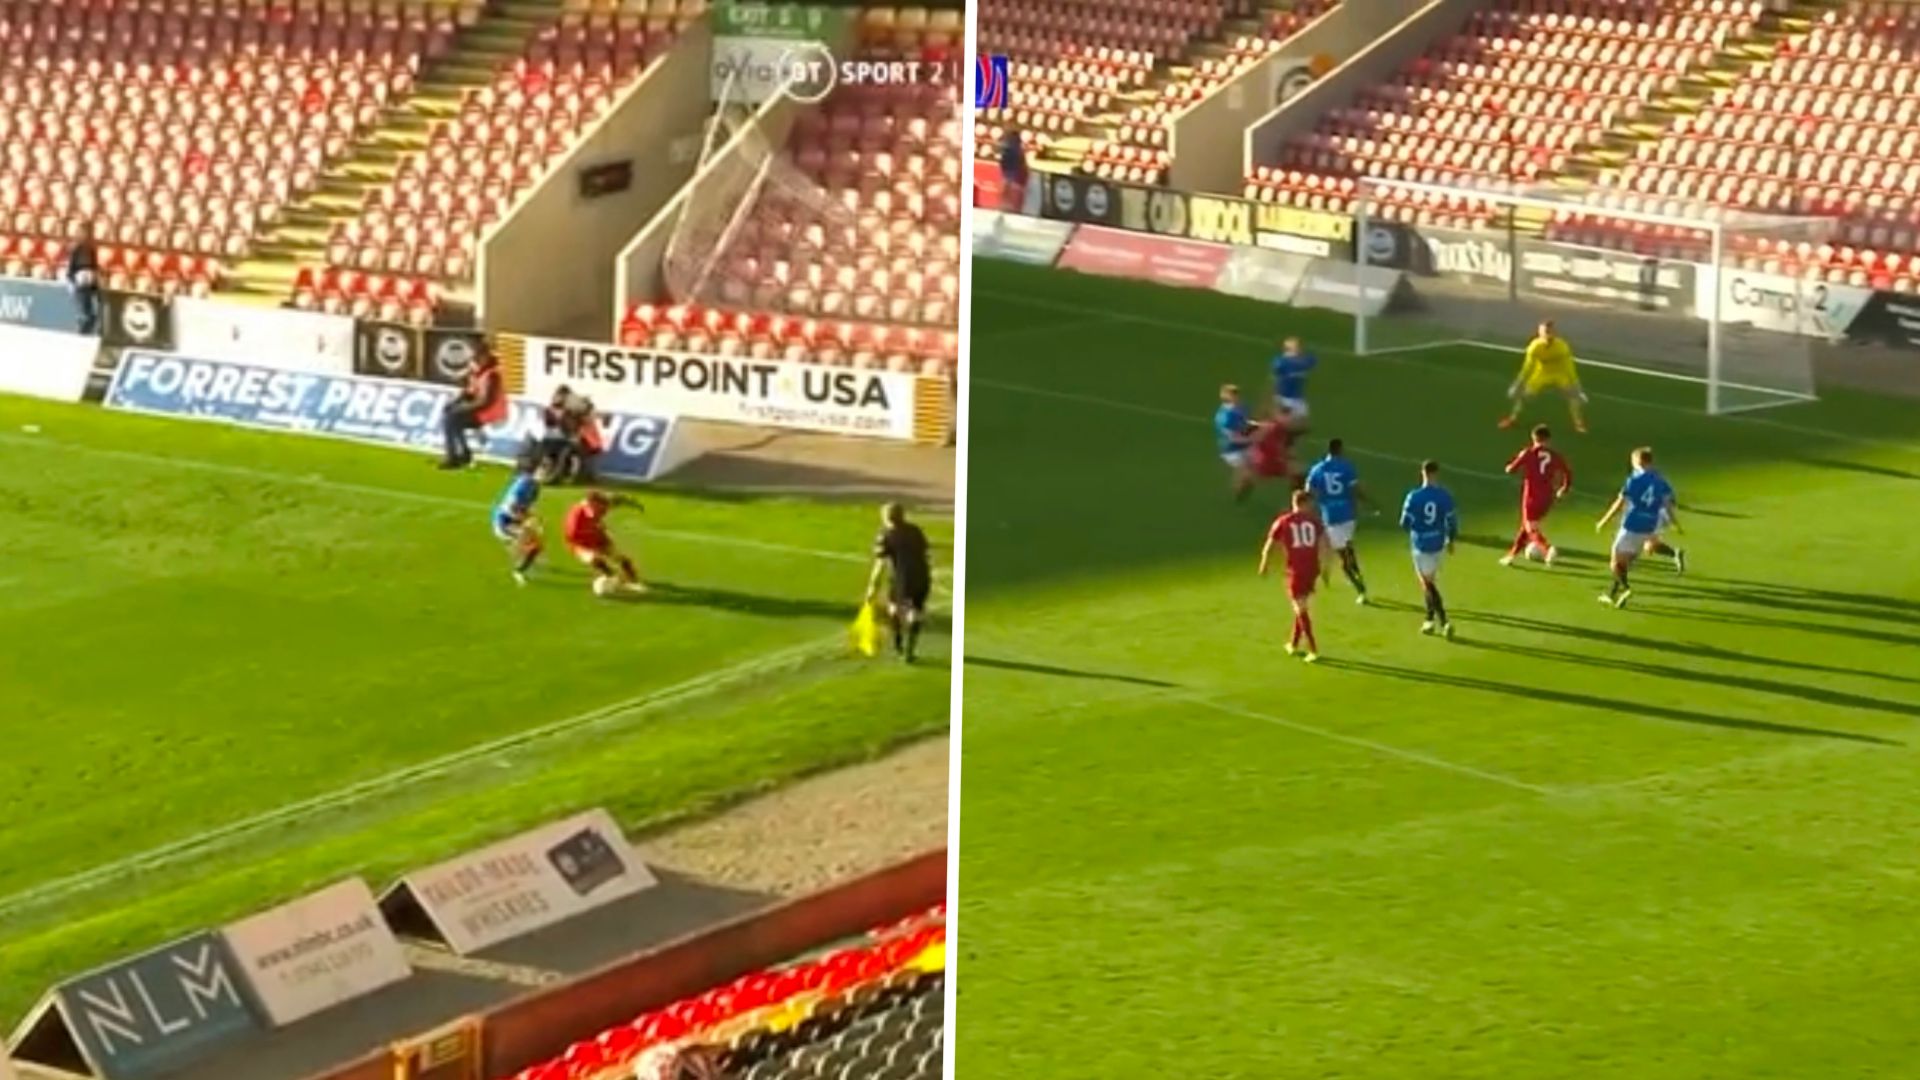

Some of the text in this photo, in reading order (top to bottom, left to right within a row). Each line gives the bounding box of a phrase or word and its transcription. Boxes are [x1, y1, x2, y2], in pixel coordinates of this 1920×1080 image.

[124, 357, 319, 410] FORREST
[544, 345, 890, 410] FIRSTPOINT USA
[1538, 451, 1551, 474] 7
[1324, 472, 1344, 495] 15
[1640, 486, 1655, 507] 4
[1423, 502, 1437, 525] 9
[1290, 522, 1316, 548] 10
[79, 943, 242, 1054] NLM
